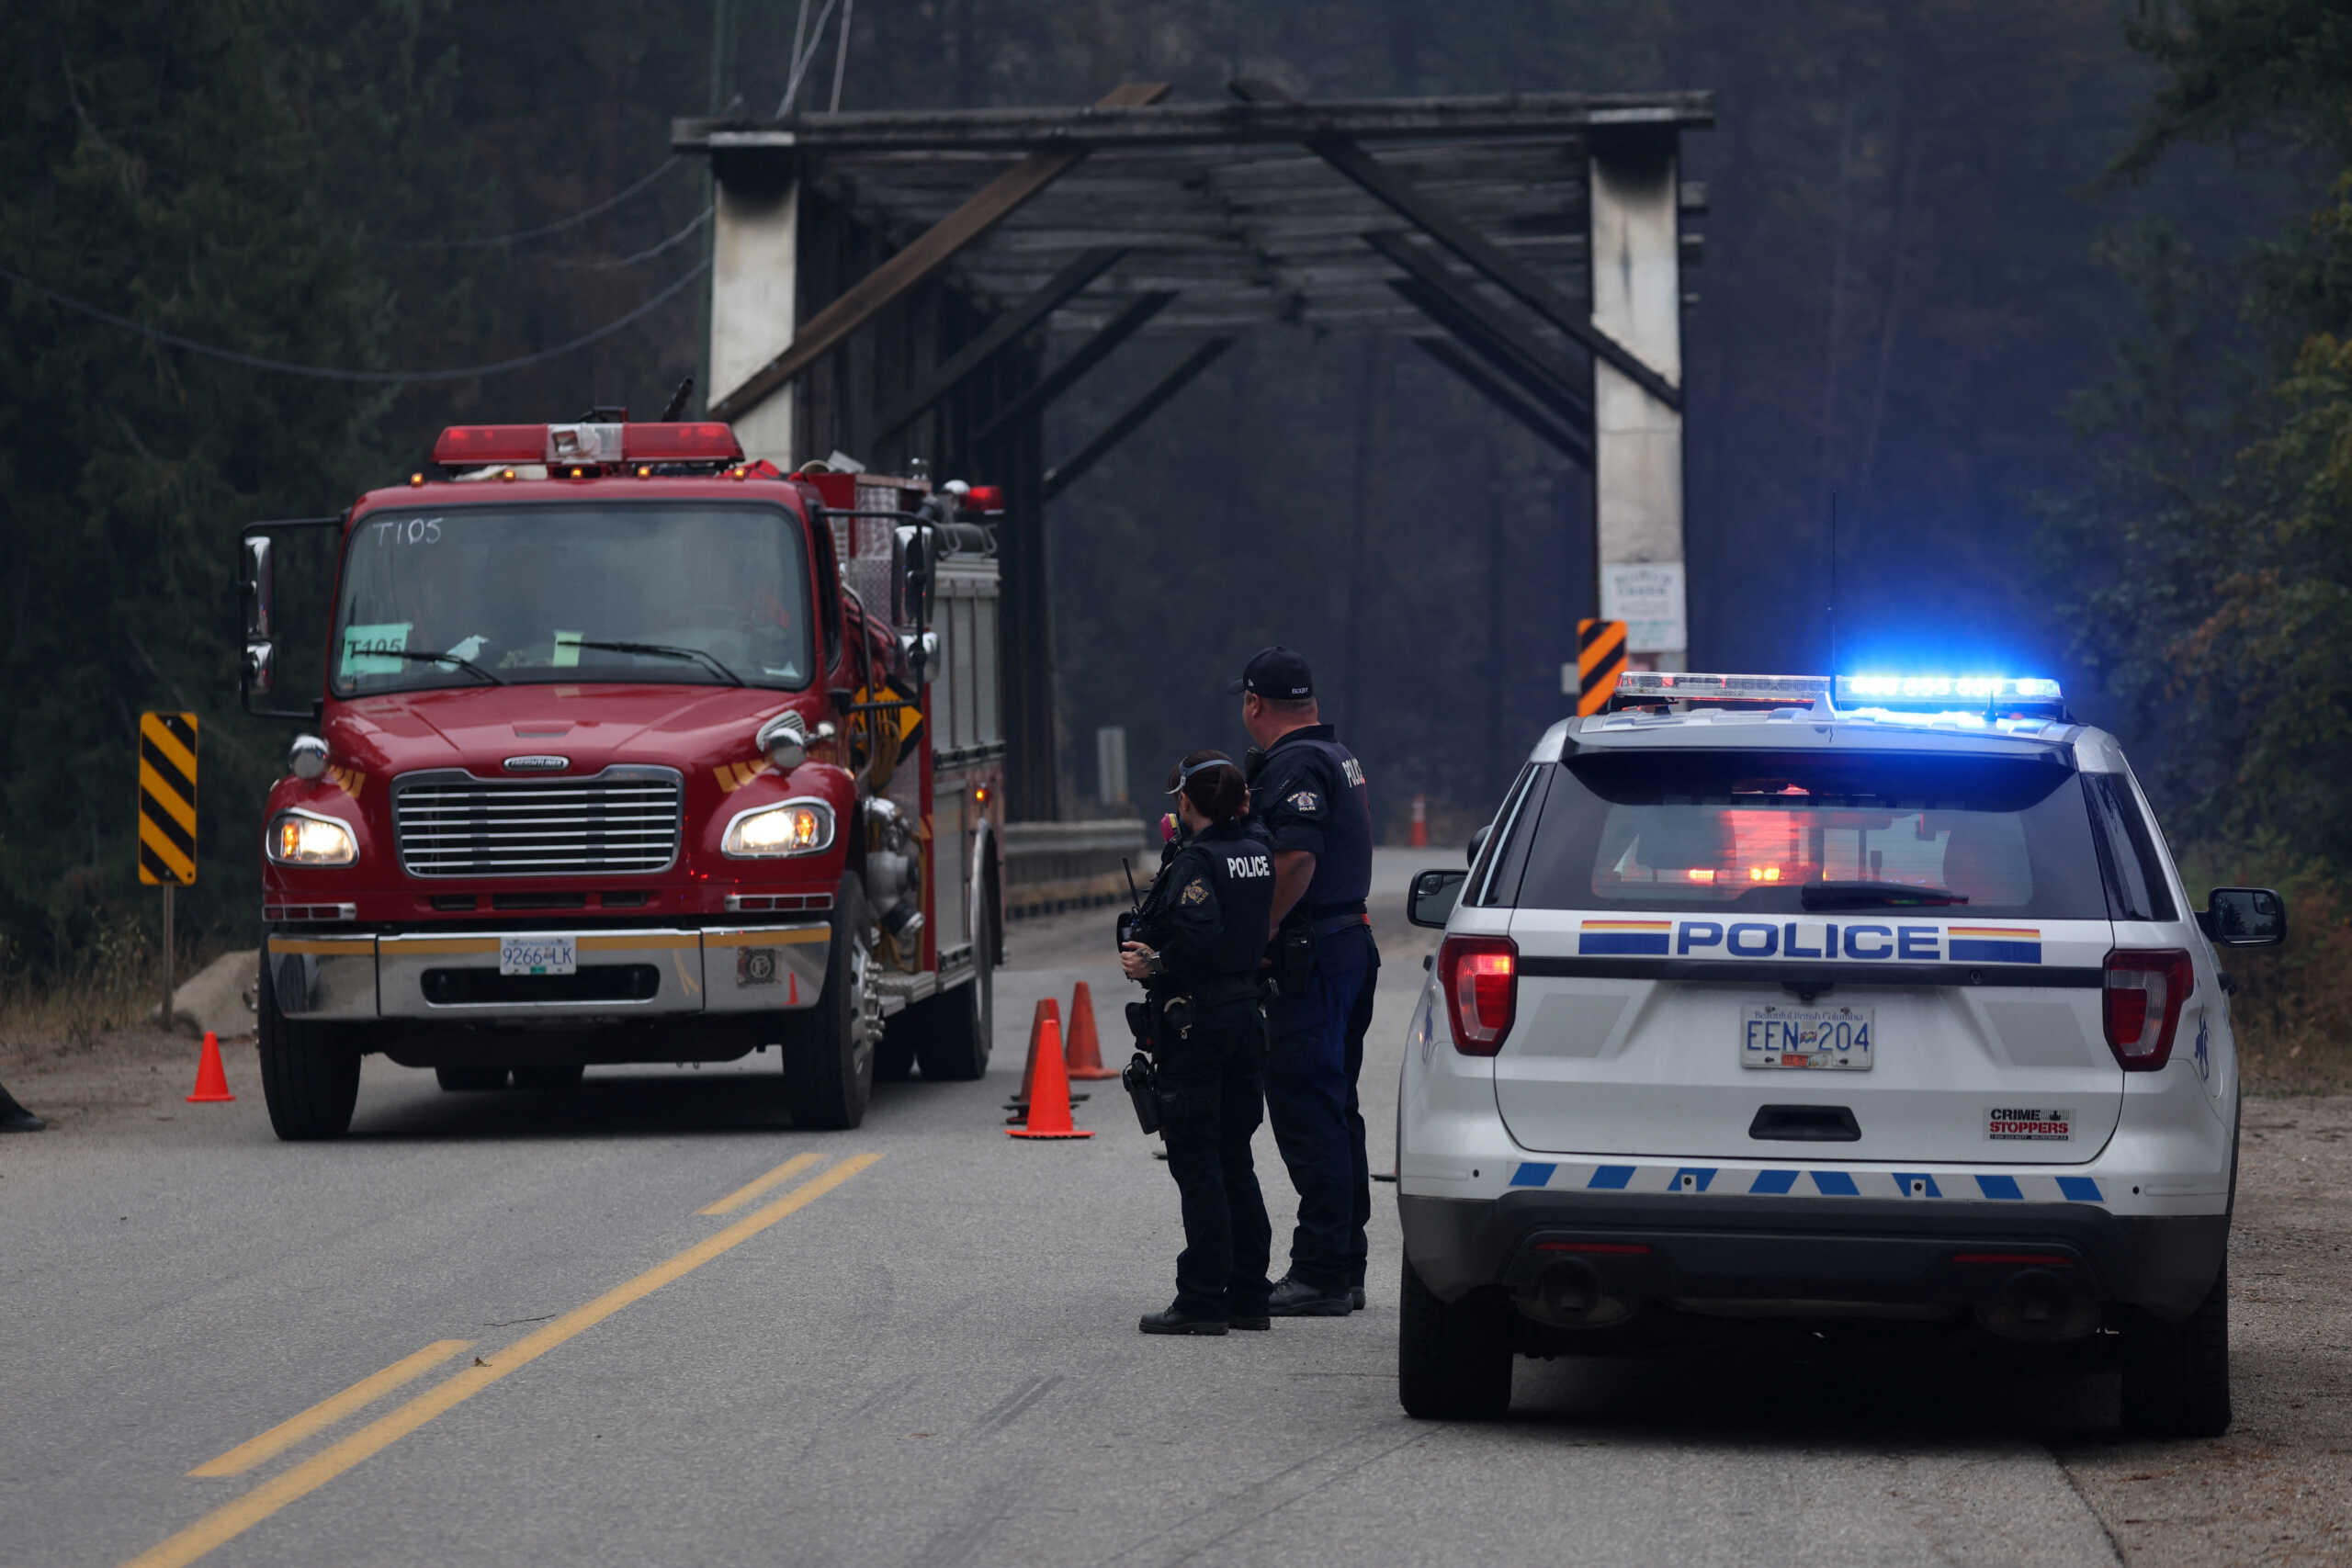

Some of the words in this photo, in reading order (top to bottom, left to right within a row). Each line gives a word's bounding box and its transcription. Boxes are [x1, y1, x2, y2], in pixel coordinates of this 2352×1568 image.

[372, 517, 444, 547] T105
[346, 638, 402, 659] T105
[1227, 855, 1271, 878] POLICE
[1677, 920, 1940, 961] POLICE
[502, 947, 543, 965] 9266
[552, 947, 572, 964] LK
[1747, 1021, 1799, 1051] EEN
[1818, 1021, 1870, 1052] 204
[1990, 1108, 2041, 1121] CRIME
[1989, 1122, 2069, 1134] STOPPERS
